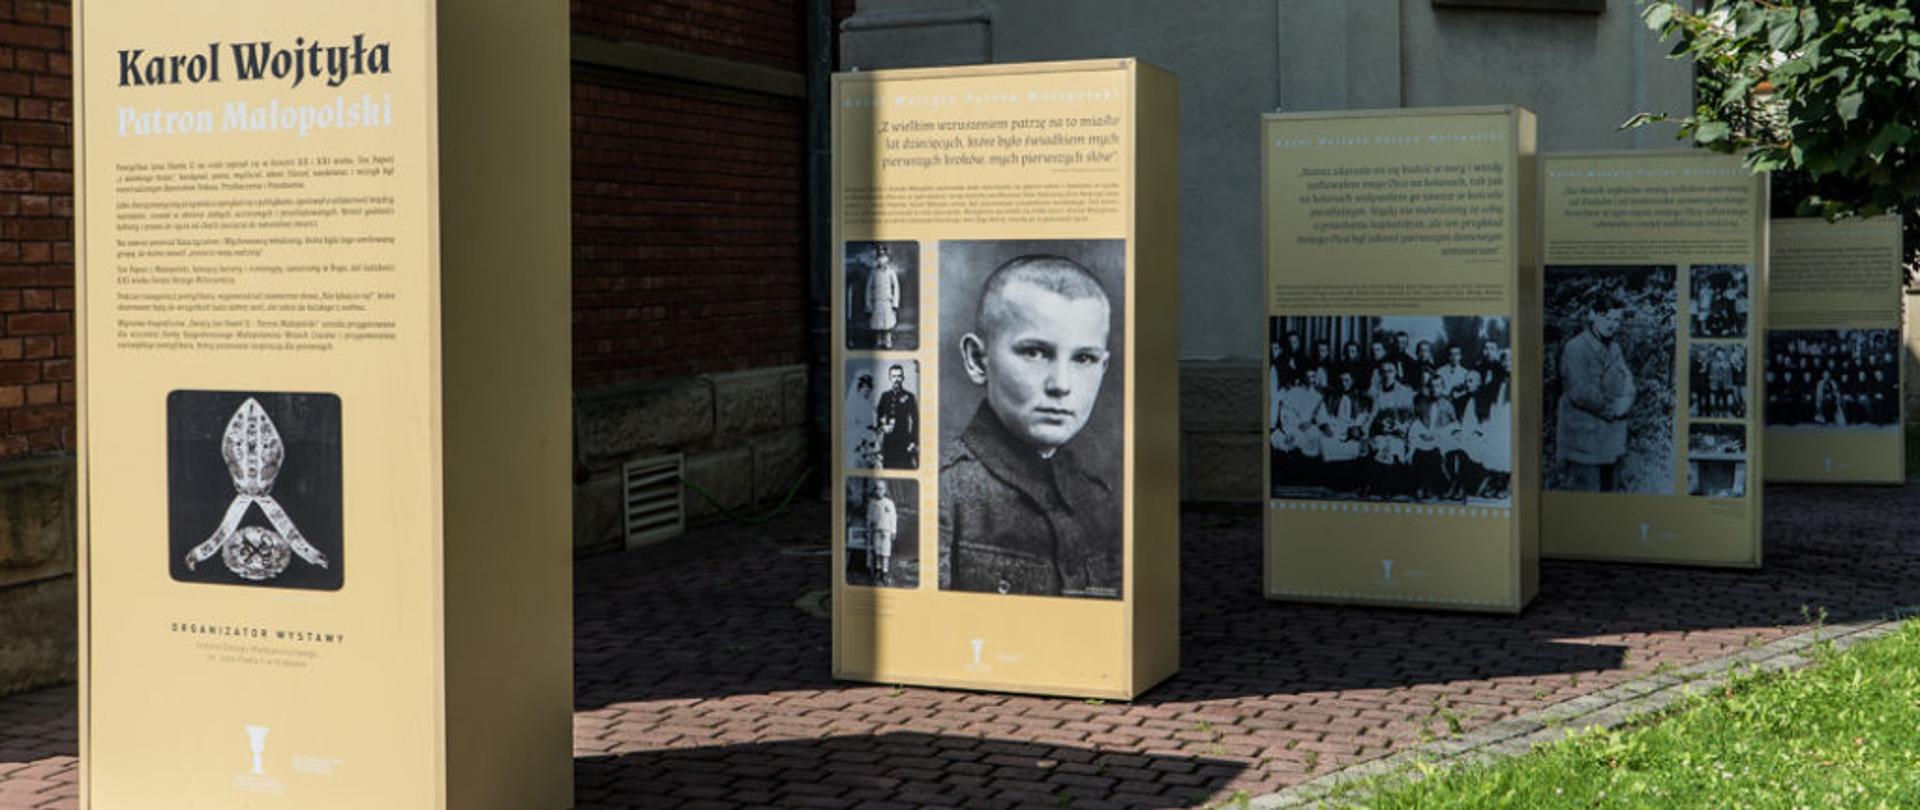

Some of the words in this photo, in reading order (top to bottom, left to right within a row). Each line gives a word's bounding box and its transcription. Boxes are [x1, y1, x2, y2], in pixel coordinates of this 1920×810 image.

[117, 43, 220, 87] Karol
[231, 34, 392, 89] Wojtyła
[117, 105, 214, 136] Patron
[221, 94, 393, 137] Małopolski
[891, 119, 935, 132] wielkim
[1010, 118, 1046, 131] patrzę
[1049, 118, 1063, 127] na
[1066, 117, 1078, 127] to
[967, 135, 996, 148] które
[1088, 131, 1120, 146] mych
[171, 622, 268, 638] ORGANIZATOR
[275, 631, 344, 644] WYSTAWY
